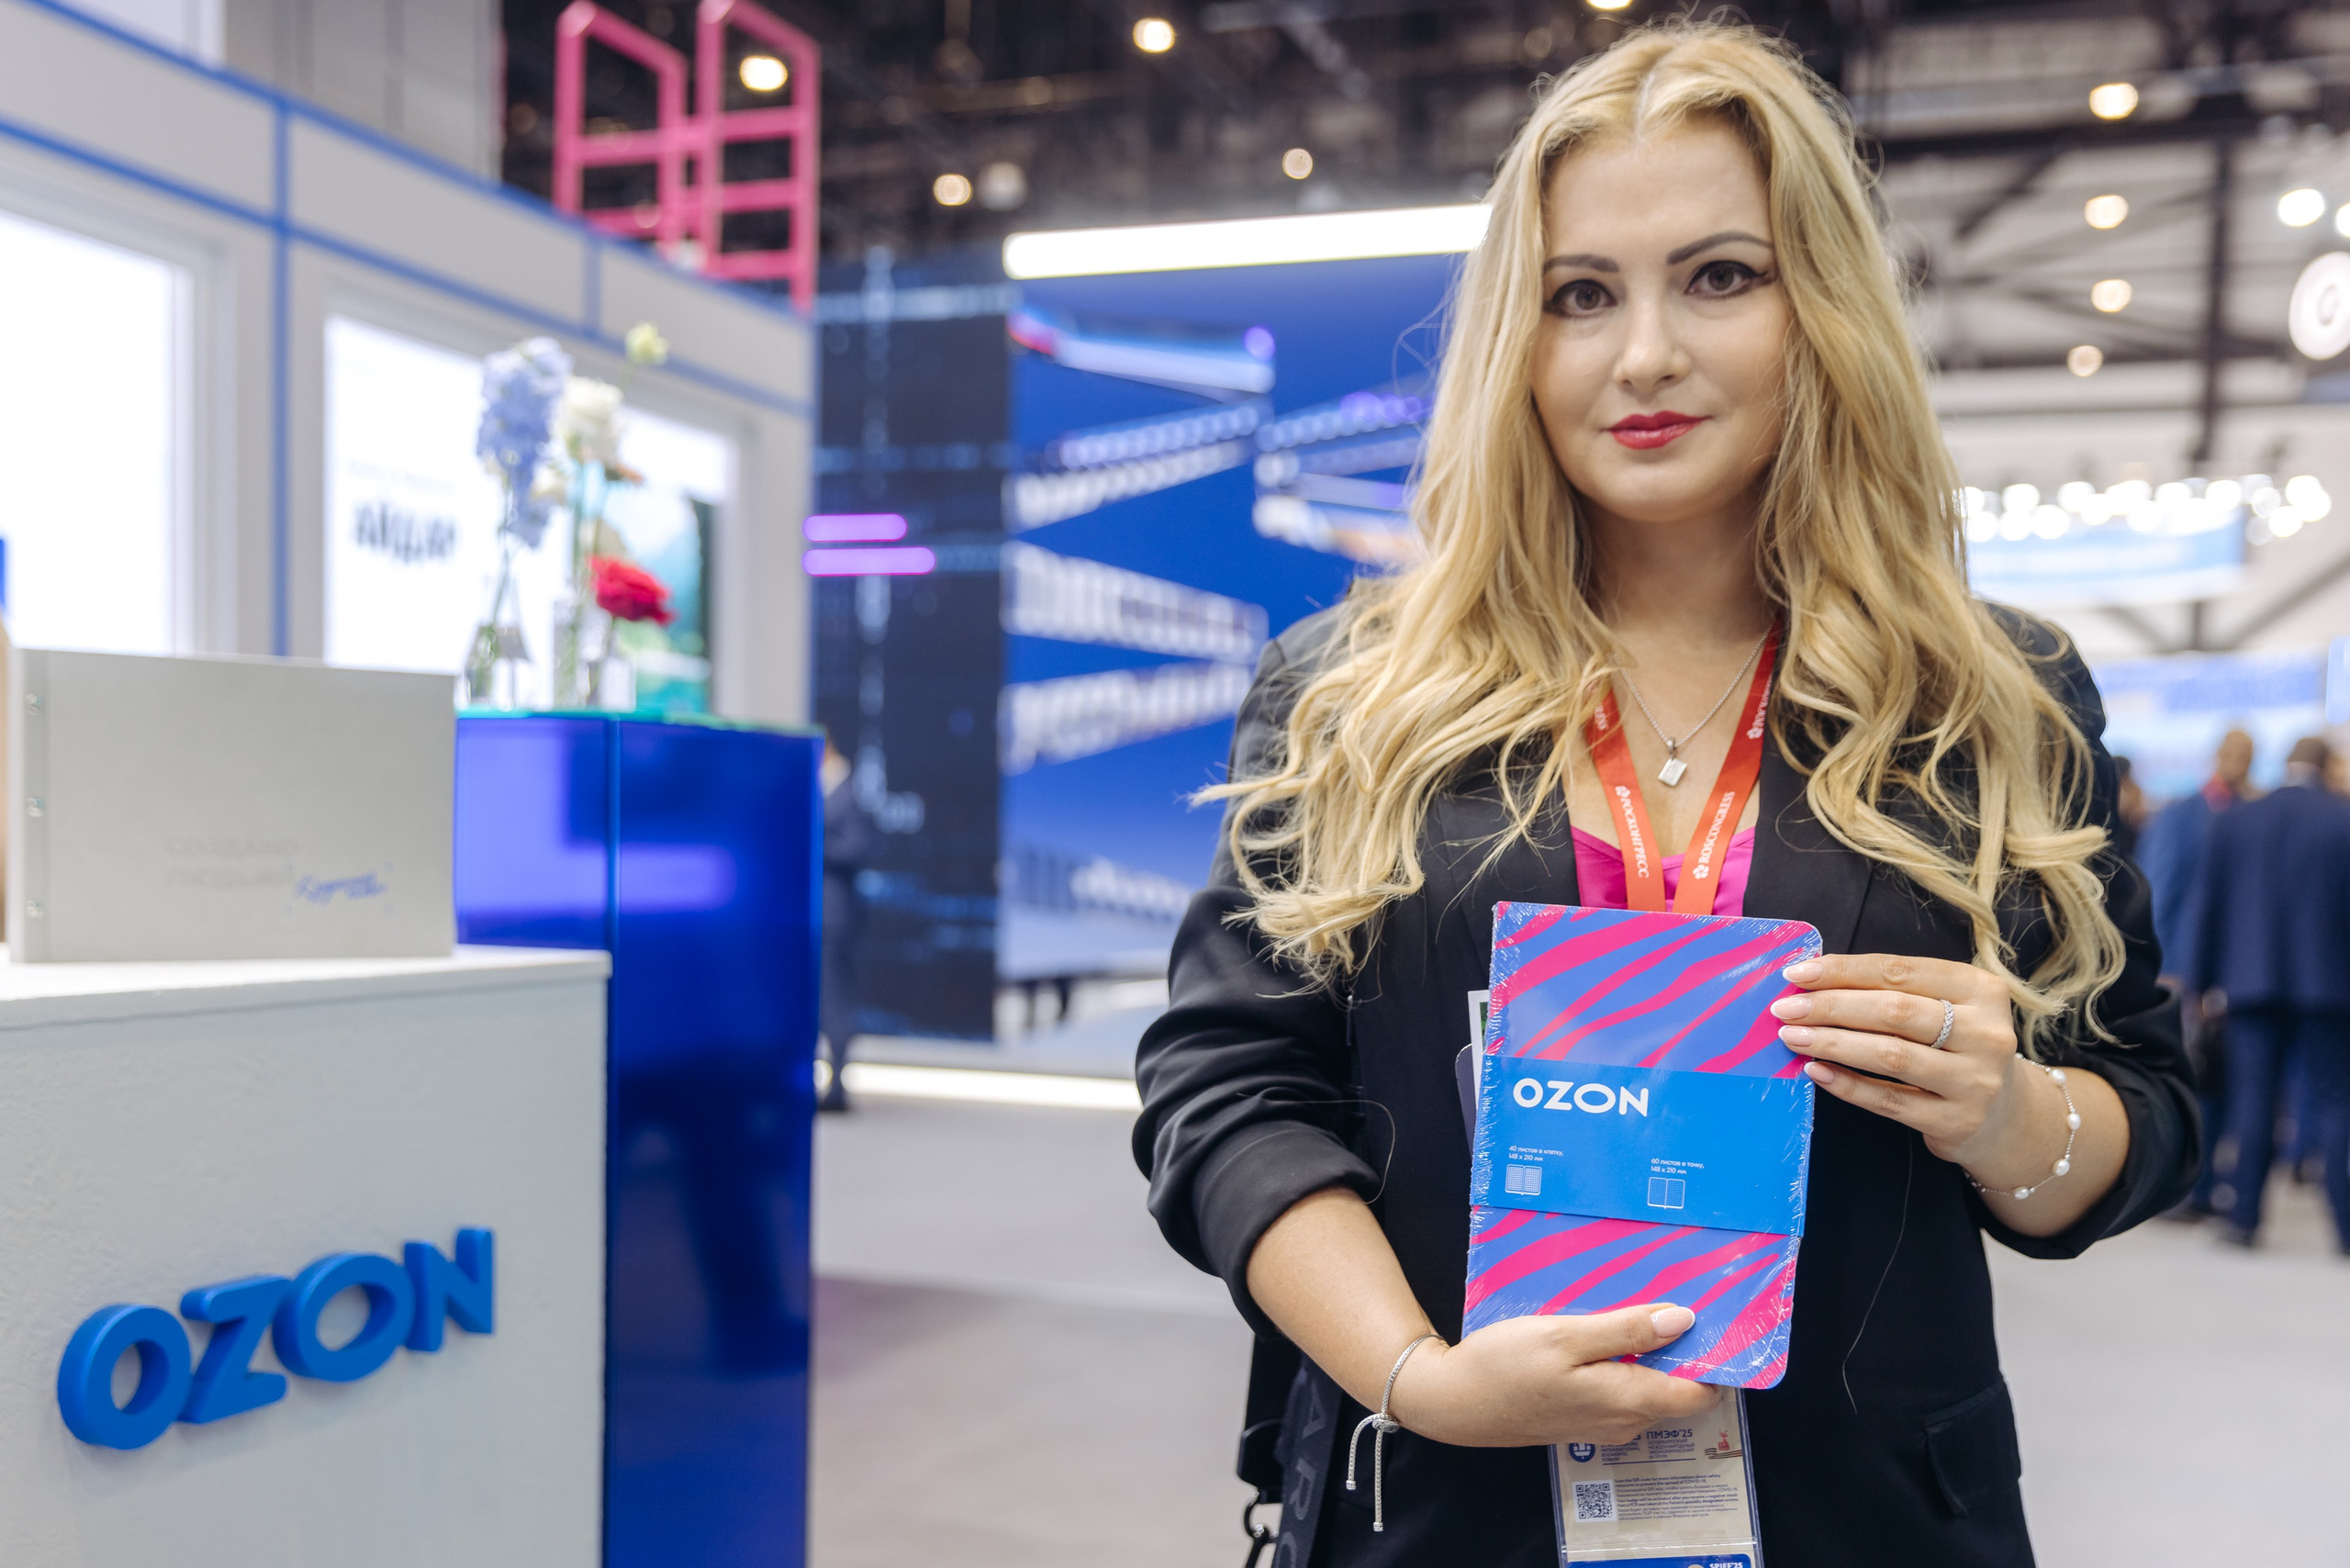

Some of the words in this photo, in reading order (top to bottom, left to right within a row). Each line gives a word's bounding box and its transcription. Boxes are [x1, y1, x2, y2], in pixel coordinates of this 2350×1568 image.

[1620, 797, 1650, 879] РОСКОНГРЕСС
[1698, 791, 1735, 864] ROSCONGRESS
[1512, 1078, 1649, 1118] OZON
[57, 1226, 497, 1450] OZON
